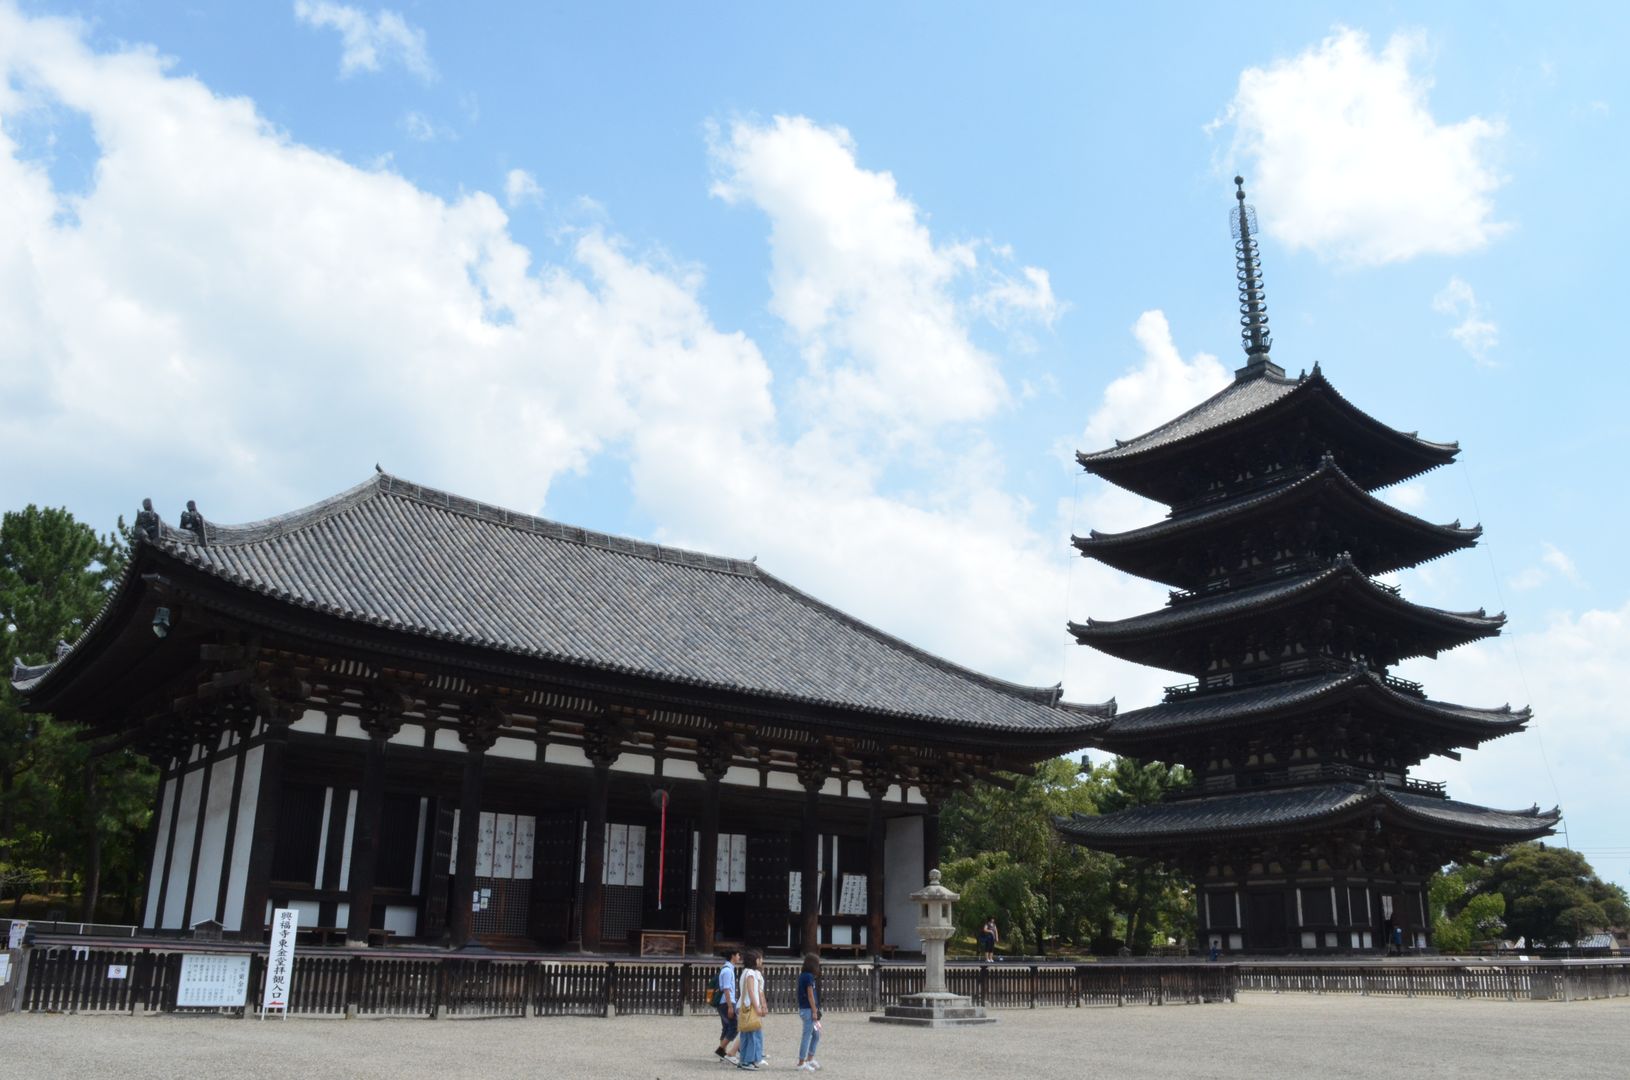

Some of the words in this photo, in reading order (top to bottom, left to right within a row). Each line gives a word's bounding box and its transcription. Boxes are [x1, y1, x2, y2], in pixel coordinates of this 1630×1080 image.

[272, 912, 292, 999] 興福寺東金堂拝観入口
